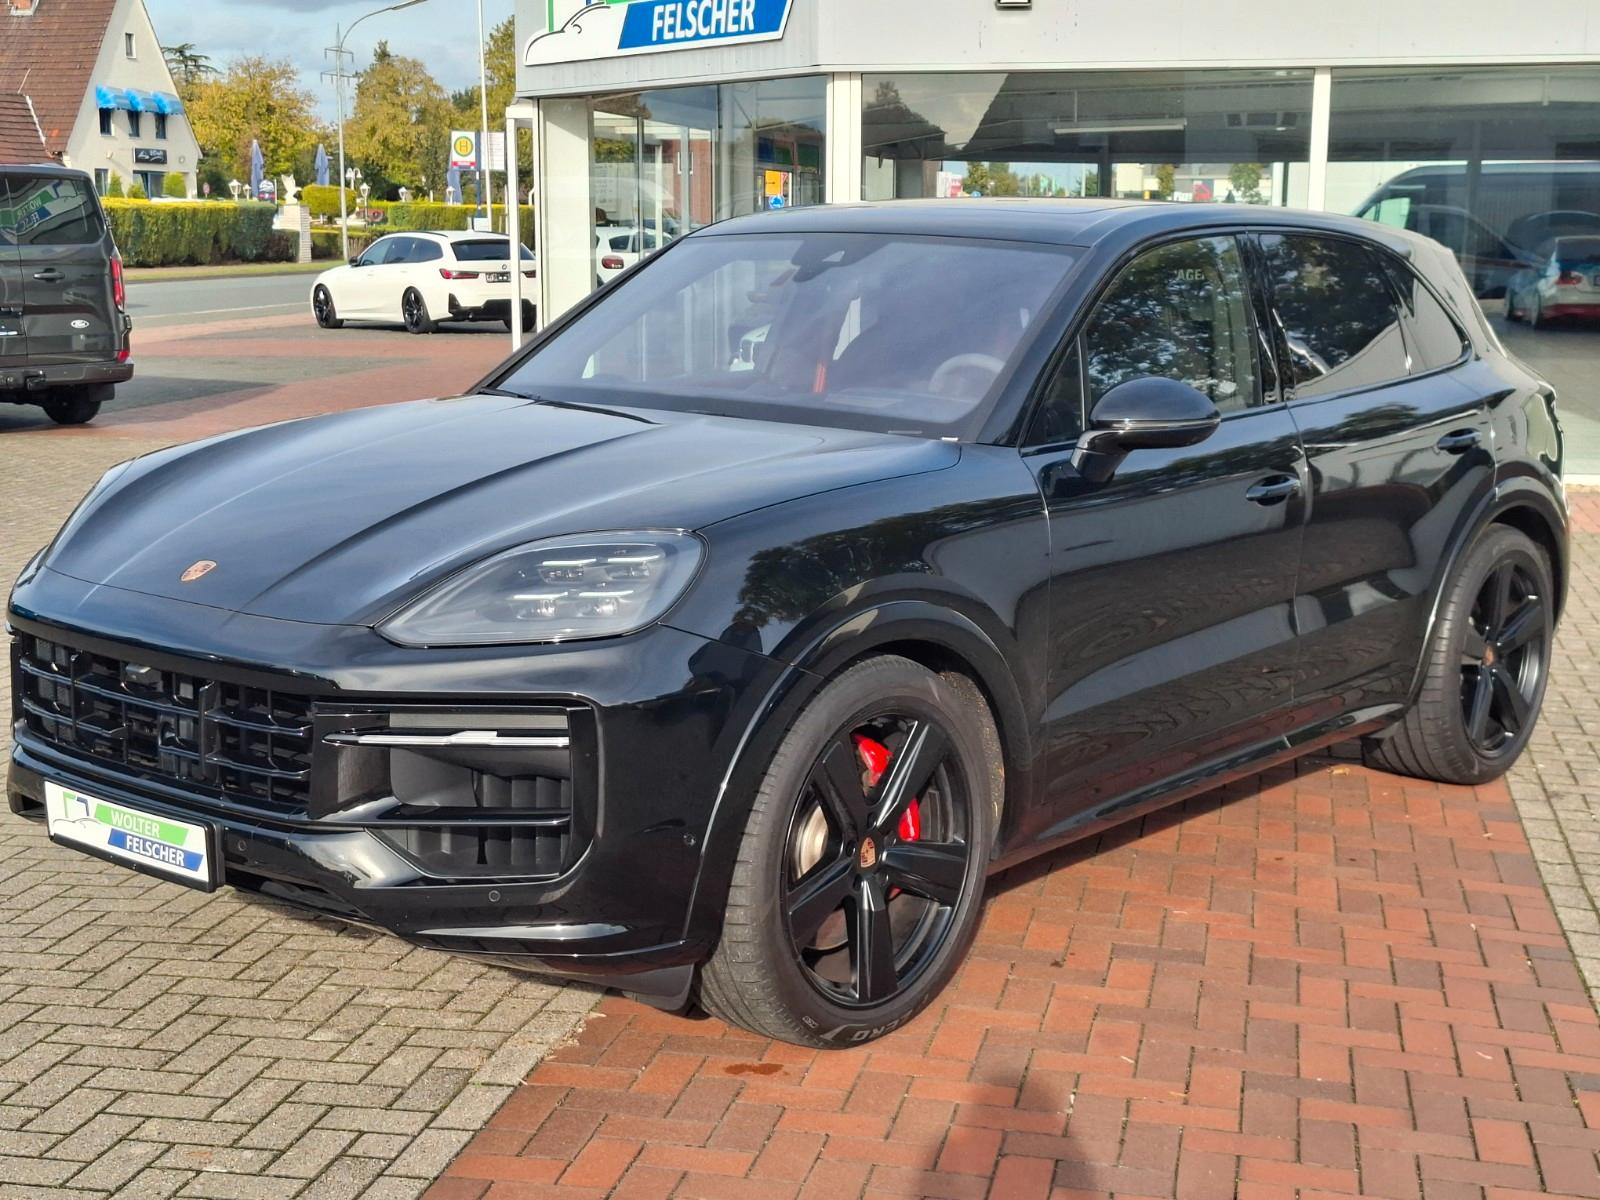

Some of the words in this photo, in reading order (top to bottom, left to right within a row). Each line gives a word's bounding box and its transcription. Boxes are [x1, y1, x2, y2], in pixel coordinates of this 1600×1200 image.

[652, 0, 756, 42] FELSCHER
[110, 809, 161, 838] WOLTER
[126, 835, 185, 867] FELSCHER
